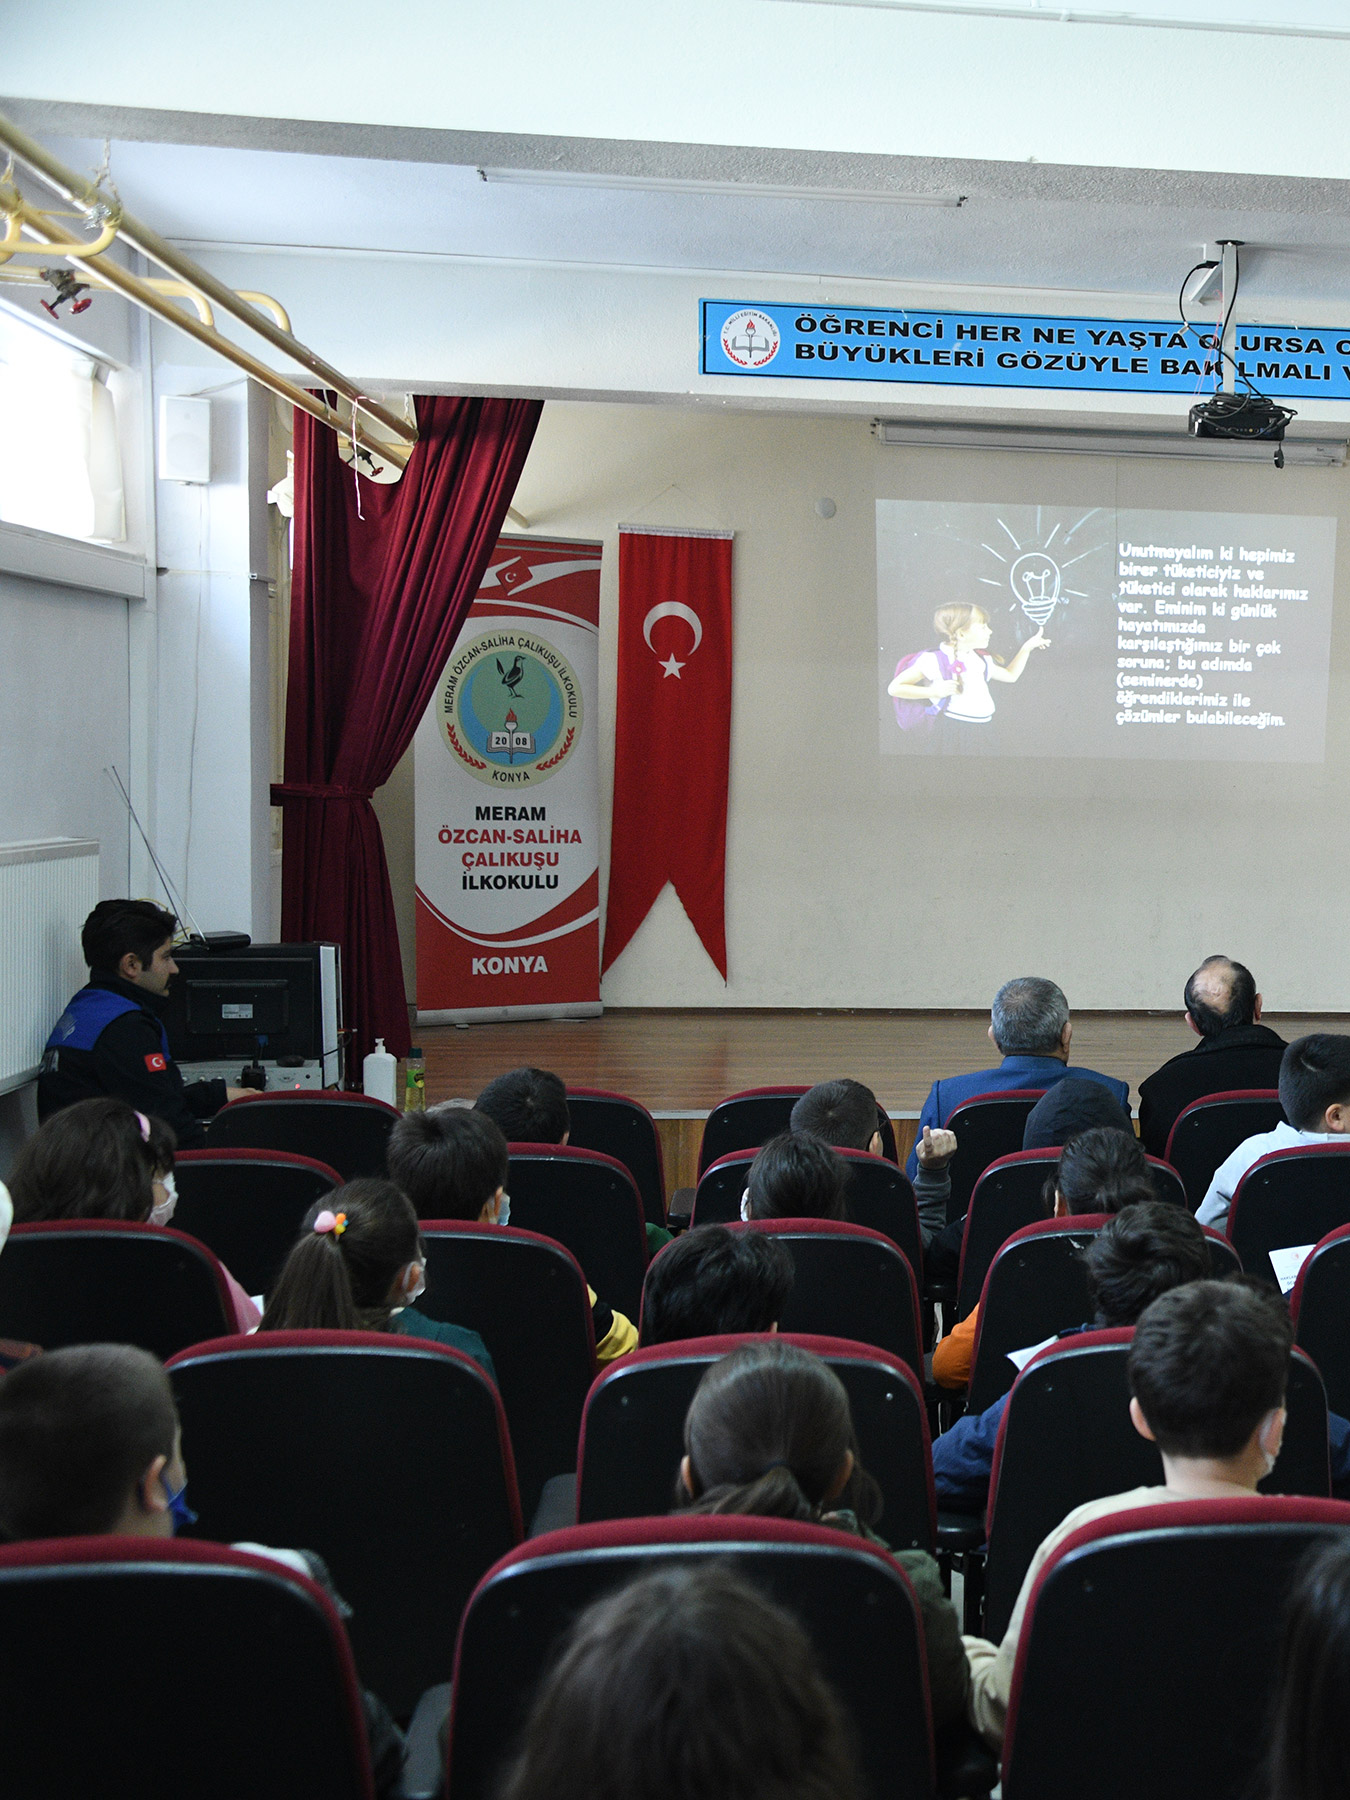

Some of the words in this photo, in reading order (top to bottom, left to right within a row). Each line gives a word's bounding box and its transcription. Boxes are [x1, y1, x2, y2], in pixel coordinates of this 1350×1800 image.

[795, 313, 943, 339] ÖĞRENCİ
[956, 324, 1022, 342] HER
[1033, 328, 1076, 344] NE
[1087, 329, 1188, 351] YAŞTA
[1198, 334, 1325, 354] OURSA
[795, 341, 984, 368] BÜYÜKLERİ
[997, 350, 1149, 374] GÖZÜYLE
[1160, 359, 1331, 381] BAKLMALI
[1118, 542, 1214, 563] Unutmayalım
[1219, 546, 1234, 561] ki
[1239, 546, 1296, 566] hepimiz
[1118, 561, 1159, 577] birer
[1162, 563, 1242, 583] tüketiciyiz
[1246, 568, 1265, 581] ve
[1118, 580, 1176, 597] tüketici
[1181, 582, 1228, 598] olarak
[1233, 583, 1309, 601] haklarımız
[1117, 601, 1148, 615] var.
[1154, 599, 1207, 616] Eminim
[1212, 602, 1226, 616] ki
[1230, 603, 1278, 621] günlük
[1117, 617, 1206, 636] hayatımızda
[1117, 635, 1223, 655] karşılaştığımız
[1228, 638, 1251, 653] bir
[1255, 640, 1282, 658] çok
[1177, 655, 1196, 670] bu
[1200, 656, 1253, 672] adımda
[444, 675, 459, 714] MERAM
[453, 634, 515, 675] ÖZCAN-SALİHA
[517, 637, 562, 670] ÇALIKUŞU
[557, 665, 578, 719] İLKOKULU
[1116, 671, 1204, 691] (seminerde)
[1232, 693, 1251, 708] ile
[1115, 708, 1181, 726] çözümler
[1185, 709, 1286, 730] bulabileceğim.
[495, 736, 507, 745] 20
[515, 736, 528, 746] 08
[491, 769, 531, 783] KONYA
[475, 806, 547, 821] MERAM
[437, 825, 582, 844] ÖZCAN-SALİHA
[461, 852, 560, 871] ÇALIKUŞU
[462, 871, 559, 890] İLKOKULU
[471, 955, 549, 976] KONYA
